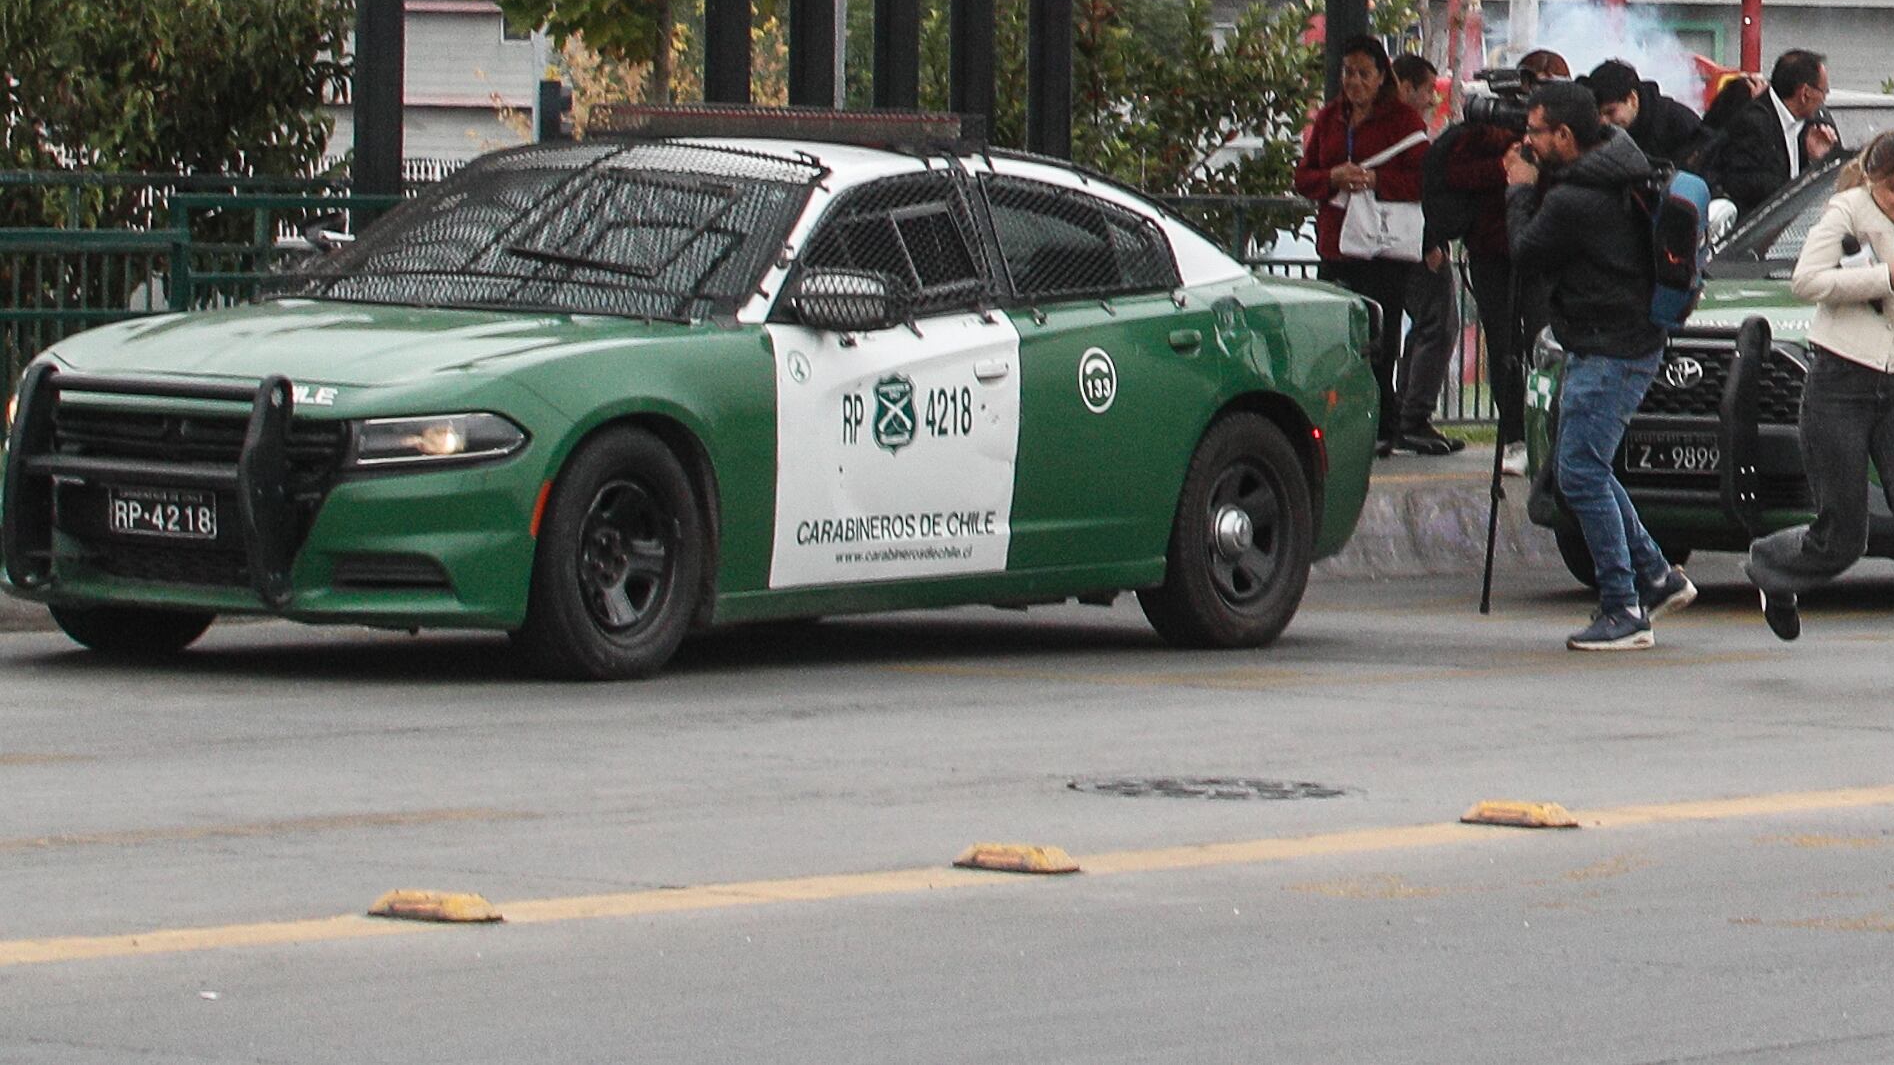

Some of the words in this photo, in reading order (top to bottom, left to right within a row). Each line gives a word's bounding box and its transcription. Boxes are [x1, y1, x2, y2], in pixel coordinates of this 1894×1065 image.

[1086, 378, 1111, 399] 133
[842, 392, 865, 444] RP
[925, 387, 973, 437] 4218
[797, 513, 916, 545] CARABINEROS
[919, 512, 943, 537] DE
[946, 510, 996, 536] CHILE
